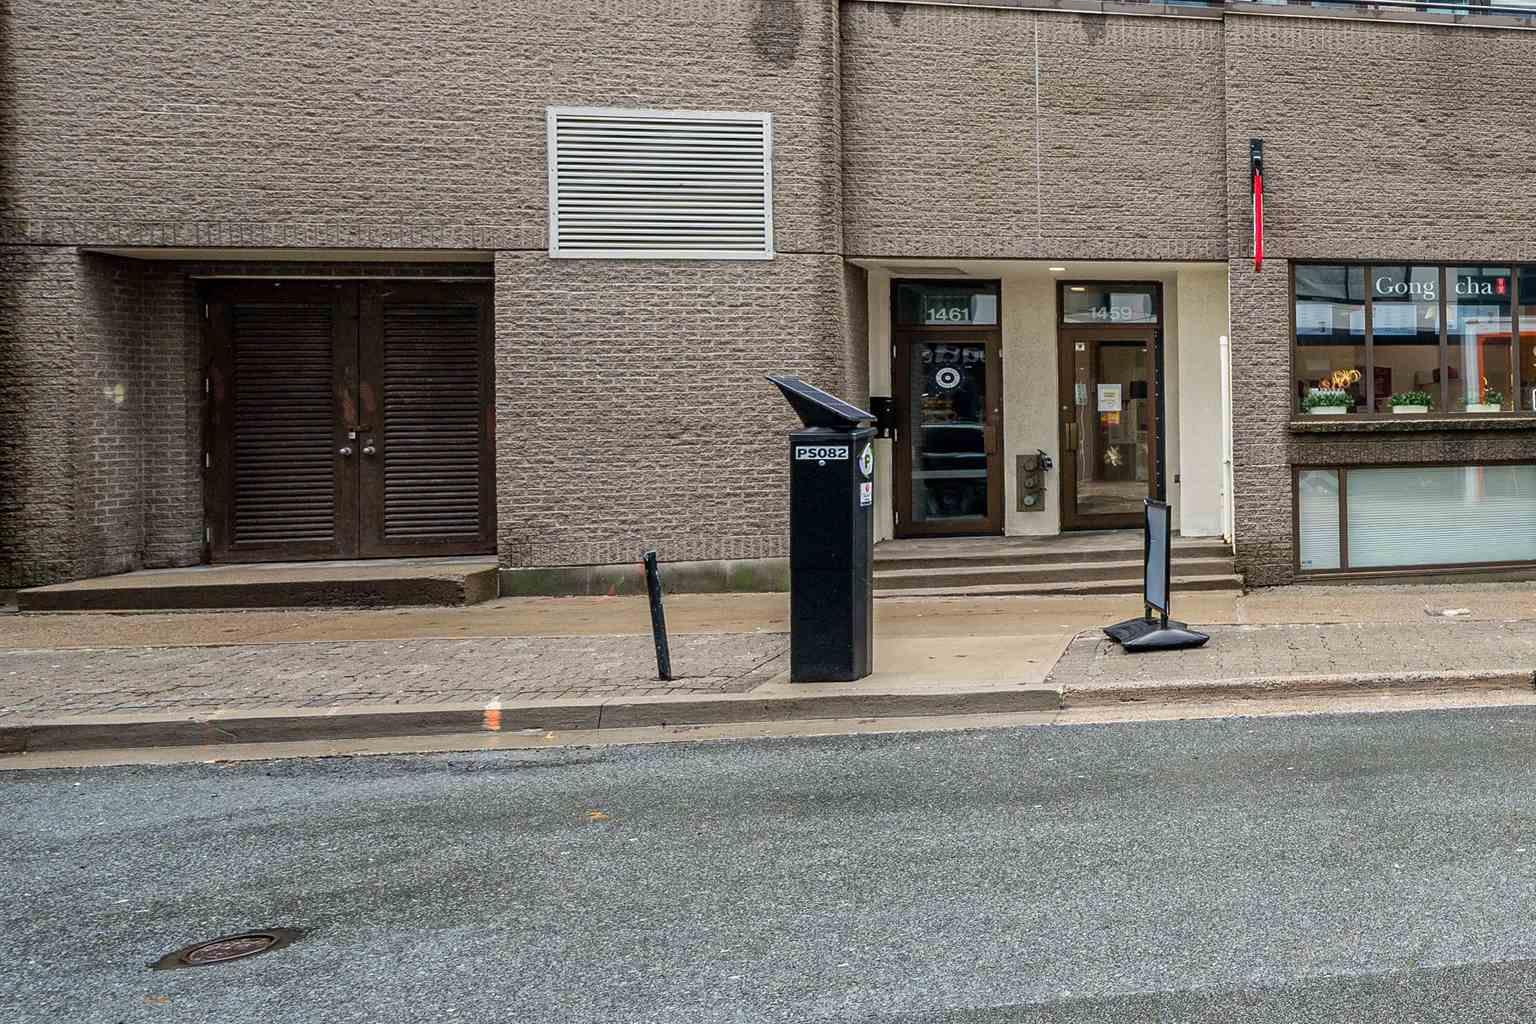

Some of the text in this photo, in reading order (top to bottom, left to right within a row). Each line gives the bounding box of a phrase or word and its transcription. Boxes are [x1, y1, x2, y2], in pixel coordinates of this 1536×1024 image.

[1375, 276, 1437, 301] Gong
[1455, 276, 1494, 295] cha
[927, 307, 971, 322] 1461
[1088, 306, 1133, 321] 1459
[797, 447, 848, 459] PS082
